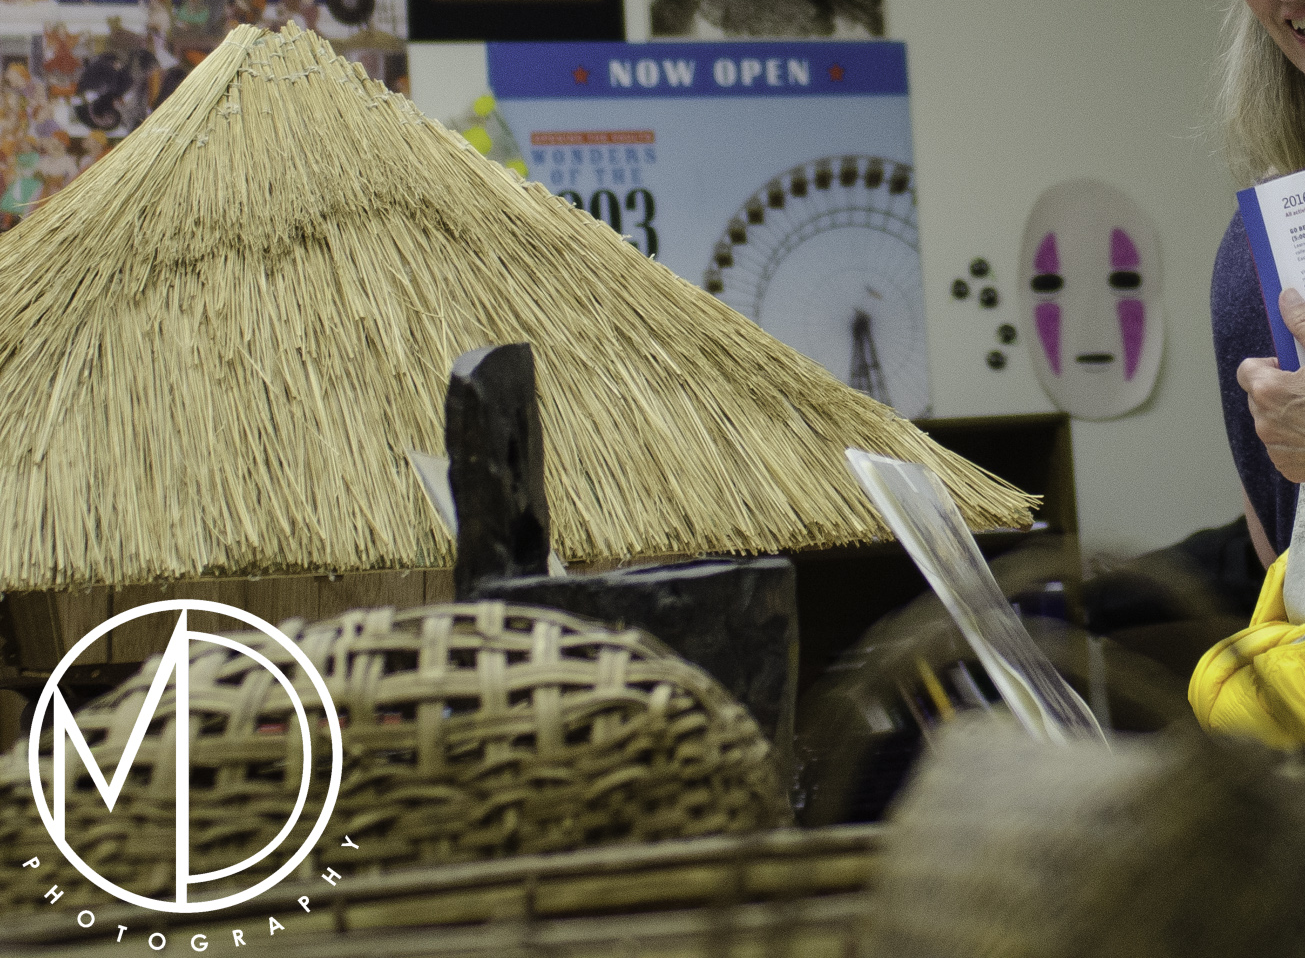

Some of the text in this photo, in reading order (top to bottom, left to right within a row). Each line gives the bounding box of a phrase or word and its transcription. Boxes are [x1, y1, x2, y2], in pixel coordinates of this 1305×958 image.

[608, 57, 811, 89] NOW OPEN
[530, 147, 657, 166] WONDERS
[549, 167, 641, 185] OF THE
